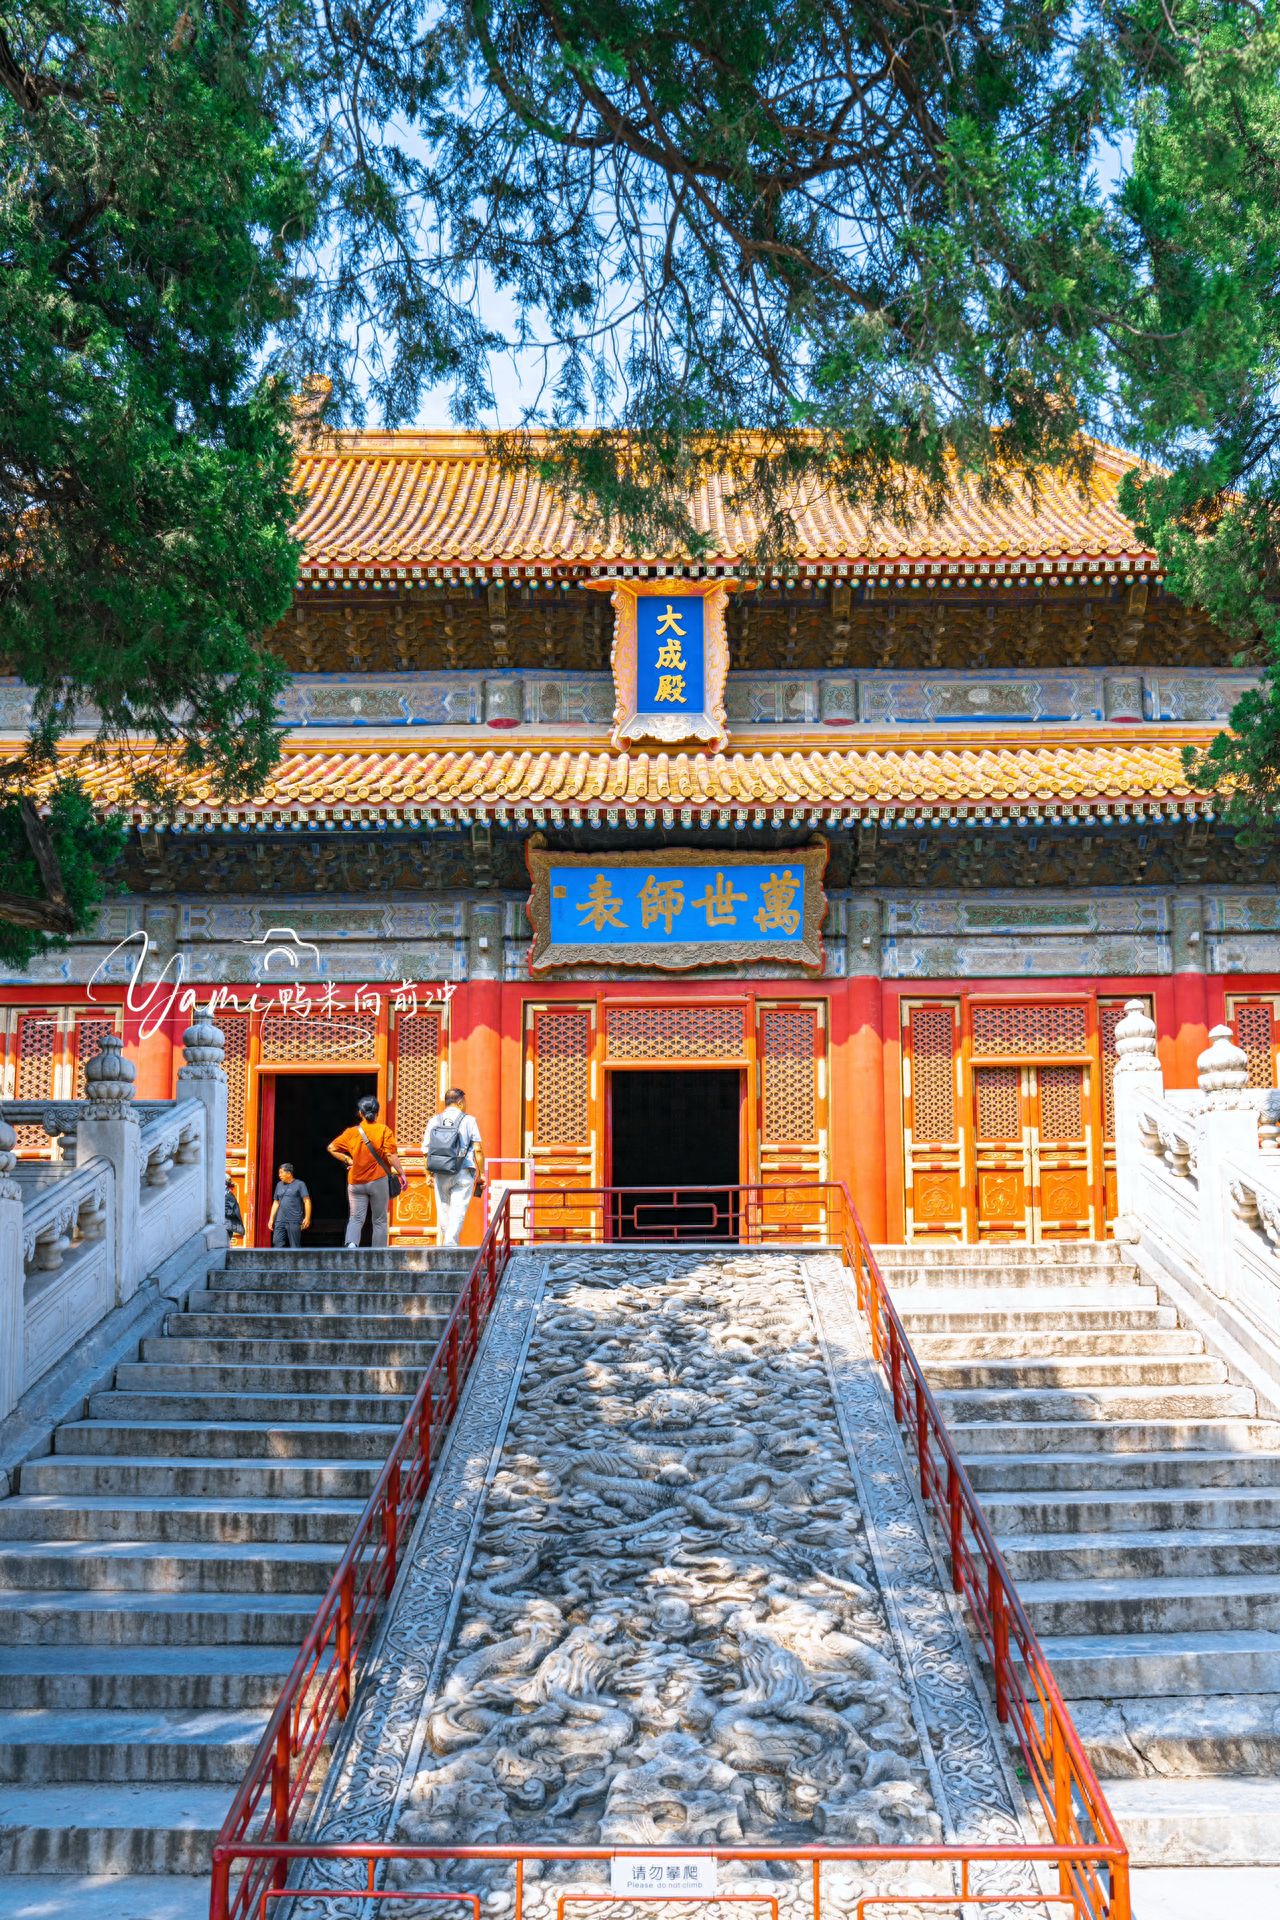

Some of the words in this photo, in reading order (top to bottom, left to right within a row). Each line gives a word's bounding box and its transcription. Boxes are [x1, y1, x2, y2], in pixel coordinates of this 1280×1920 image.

[654, 604, 688, 704] 大成殿
[632, 1865, 698, 1880] 请勿攀爬
